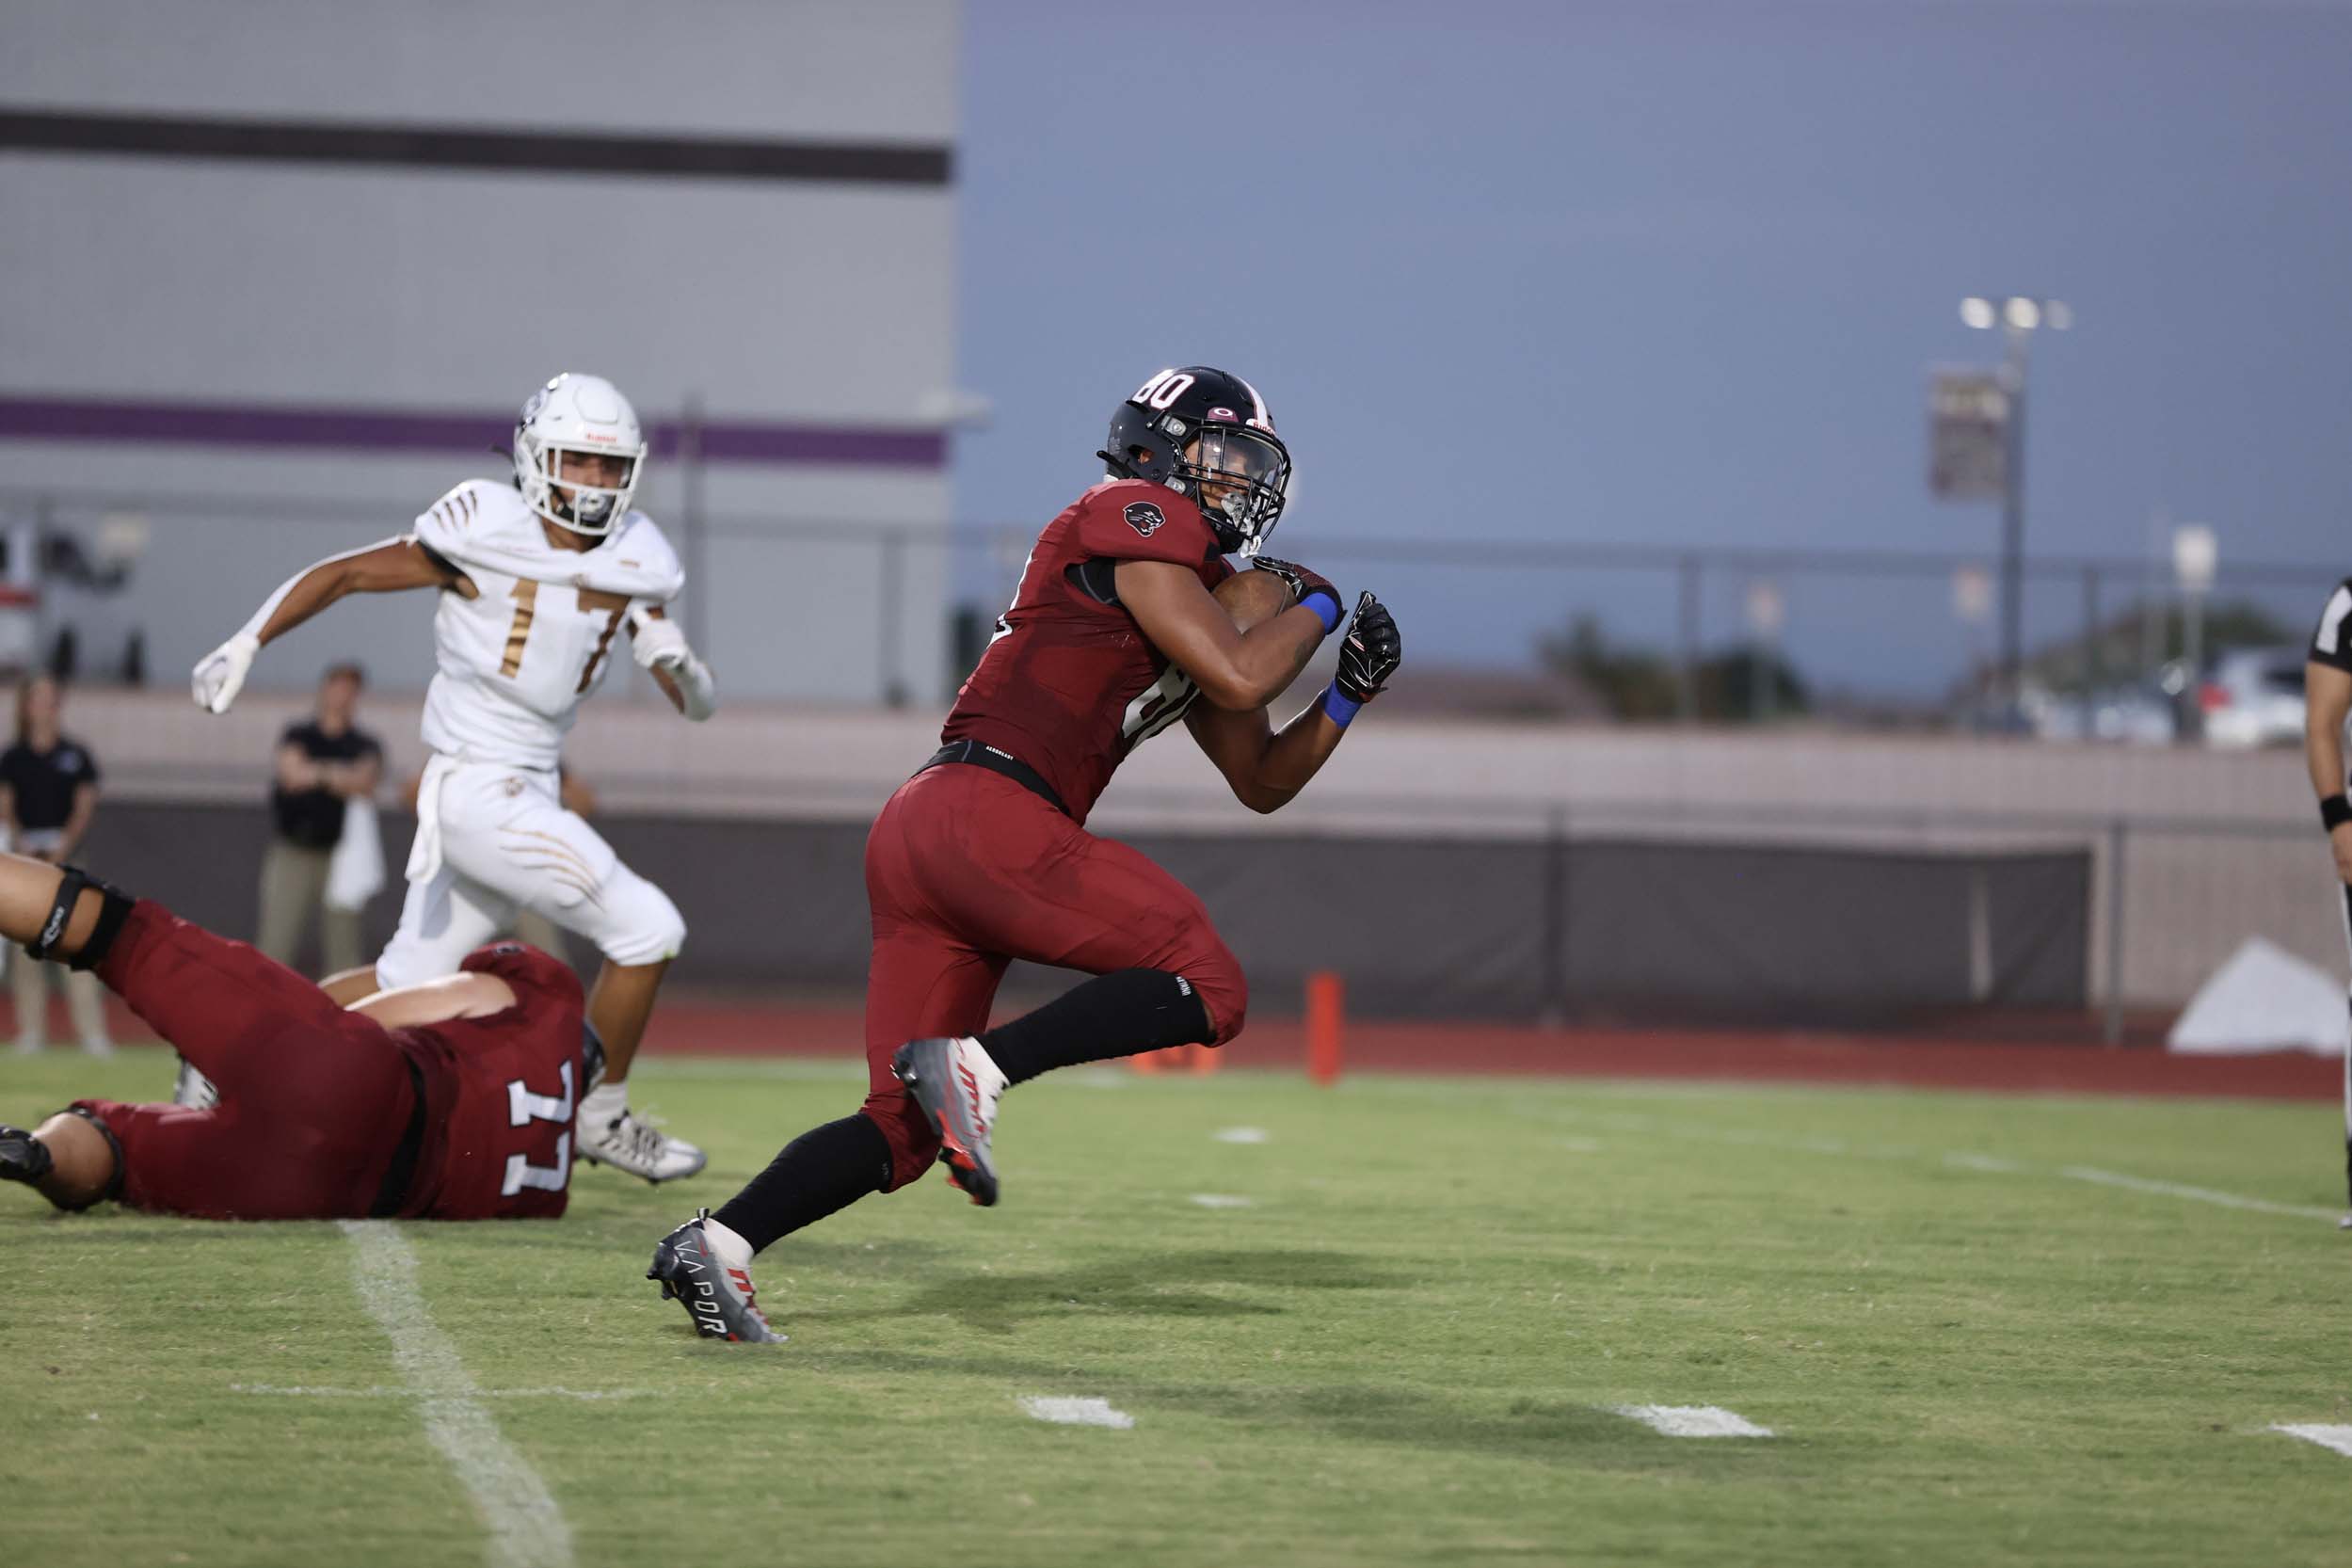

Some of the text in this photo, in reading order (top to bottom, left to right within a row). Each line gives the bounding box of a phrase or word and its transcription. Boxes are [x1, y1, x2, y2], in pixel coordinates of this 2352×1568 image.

[1132, 369, 1195, 409] 80
[499, 578, 632, 694] 17
[502, 1060, 573, 1196] 77
[673, 1240, 728, 1334] VAPOR
